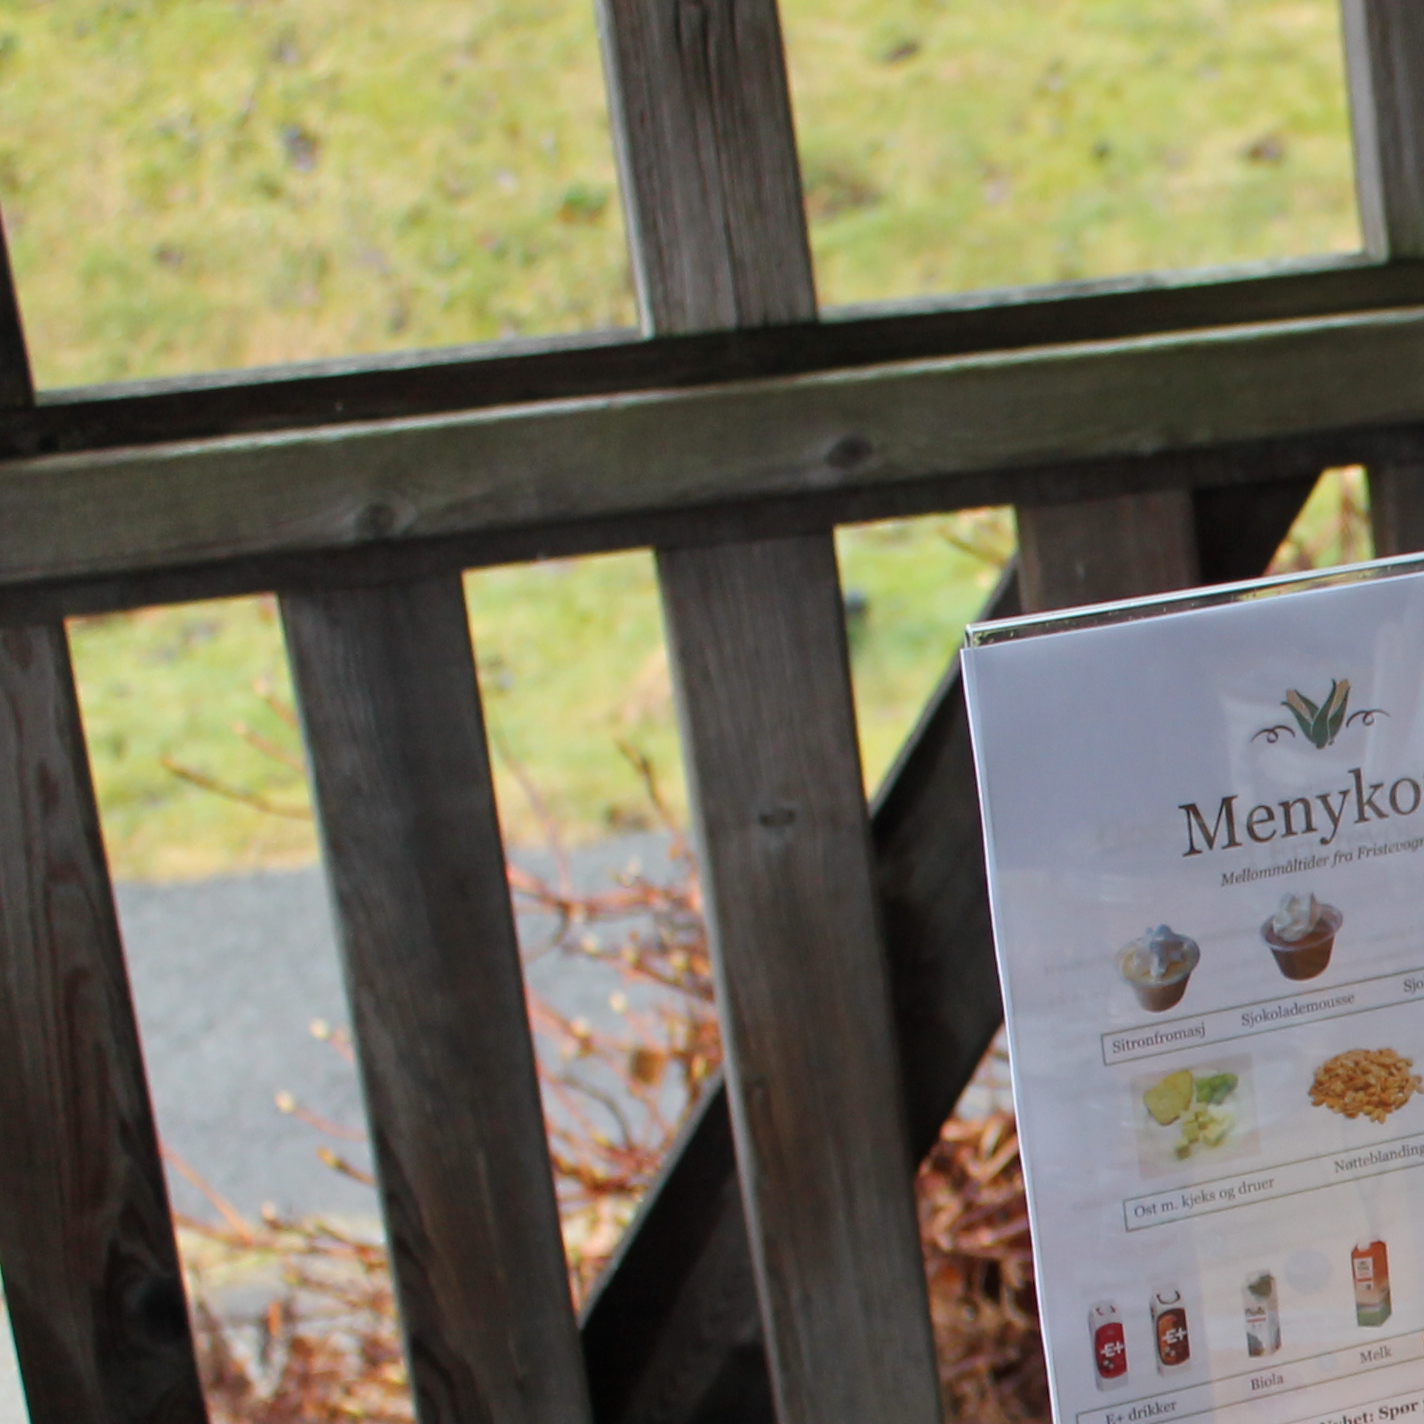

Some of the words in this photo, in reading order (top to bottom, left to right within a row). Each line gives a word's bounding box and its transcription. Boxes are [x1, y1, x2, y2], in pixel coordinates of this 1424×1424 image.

[1221, 854, 1330, 886] Mellommåltider
[1330, 849, 1354, 868] fra
[1112, 1022, 1206, 1054] Sitronfromasj
[1241, 992, 1355, 1027] Sjokolademousse
[1133, 1200, 1158, 1219] Ost
[1160, 1199, 1179, 1214] m.
[1181, 1188, 1216, 1210] kjeks
[1218, 1185, 1236, 1201] og
[1237, 1176, 1275, 1196] druer
[1128, 1399, 1177, 1422] drikker
[1251, 1373, 1284, 1391] Biola
[1360, 1346, 1392, 1364] Melk
[1378, 1398, 1421, 1421] Spør
